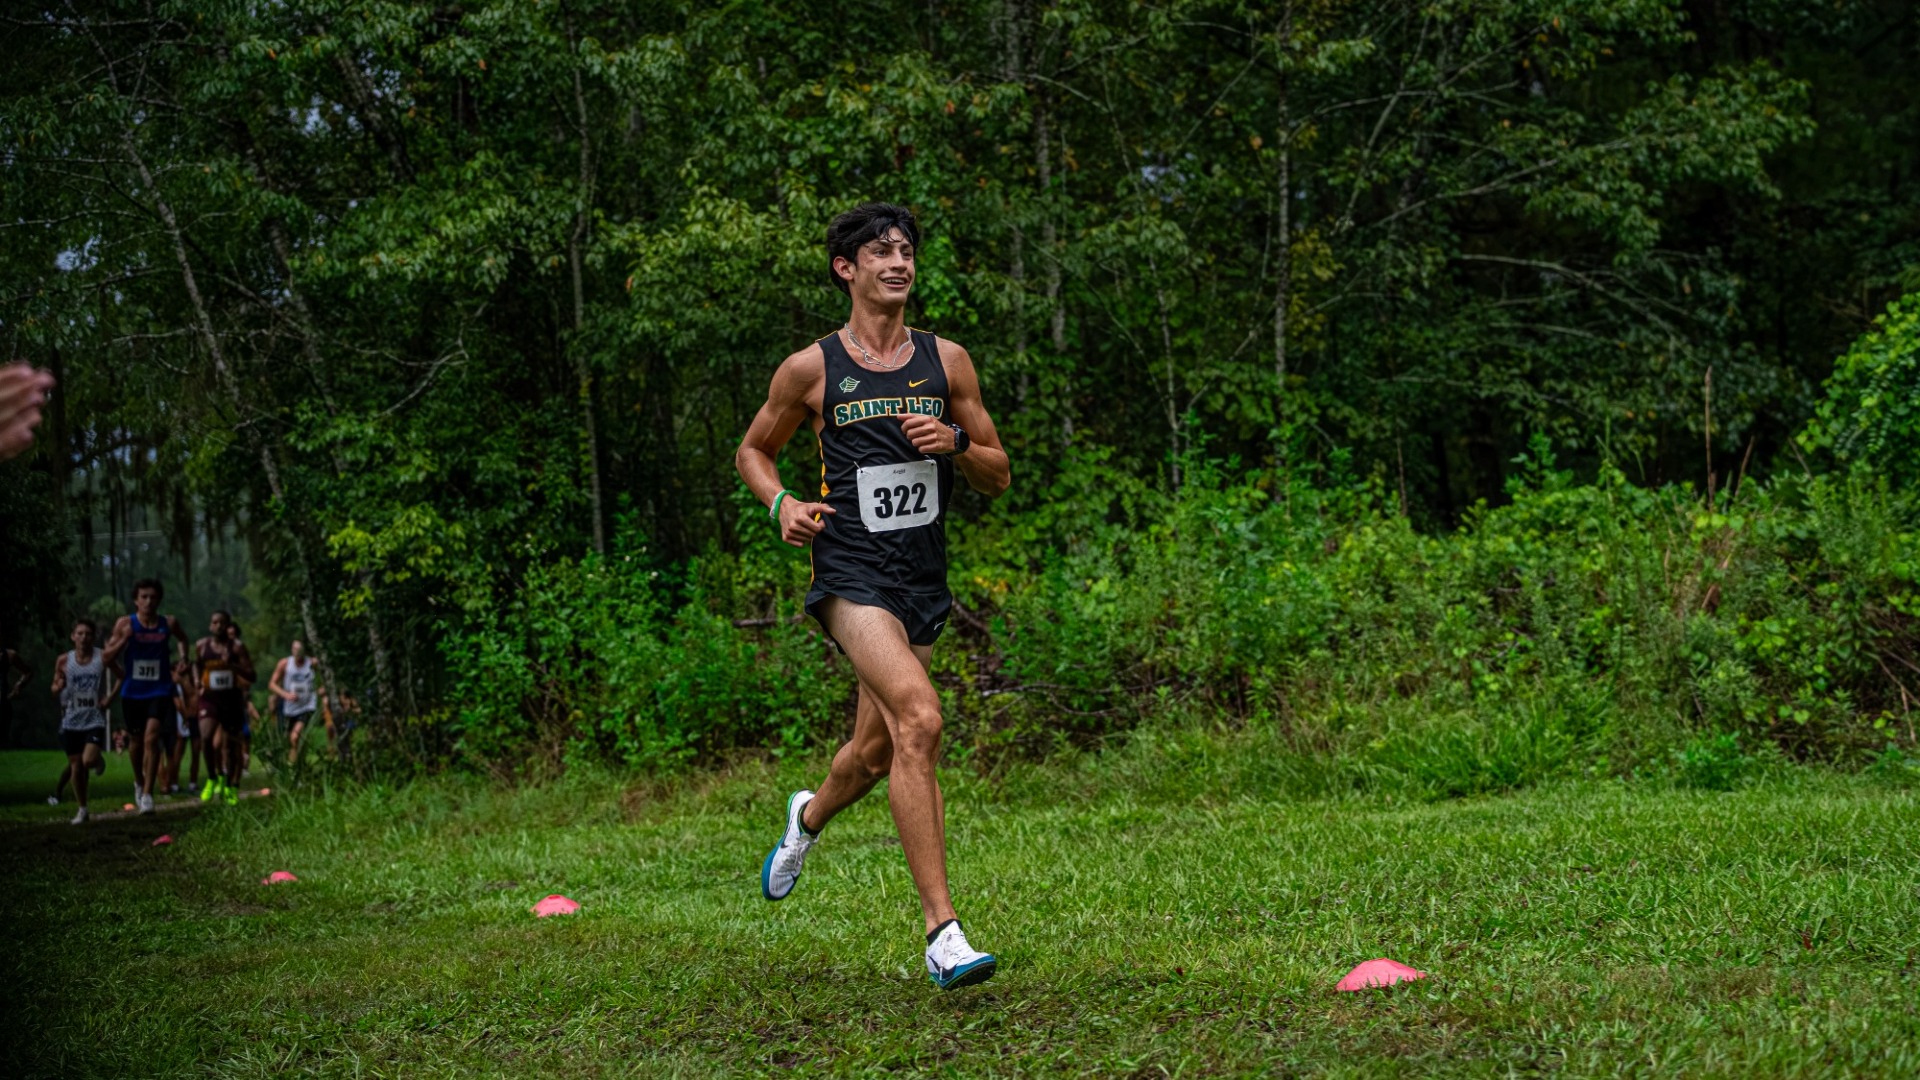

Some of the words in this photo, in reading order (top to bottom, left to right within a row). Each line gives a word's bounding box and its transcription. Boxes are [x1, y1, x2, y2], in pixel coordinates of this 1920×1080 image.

[834, 398, 902, 427] SAINT
[905, 397, 944, 420] LEO
[873, 482, 928, 519] 322
